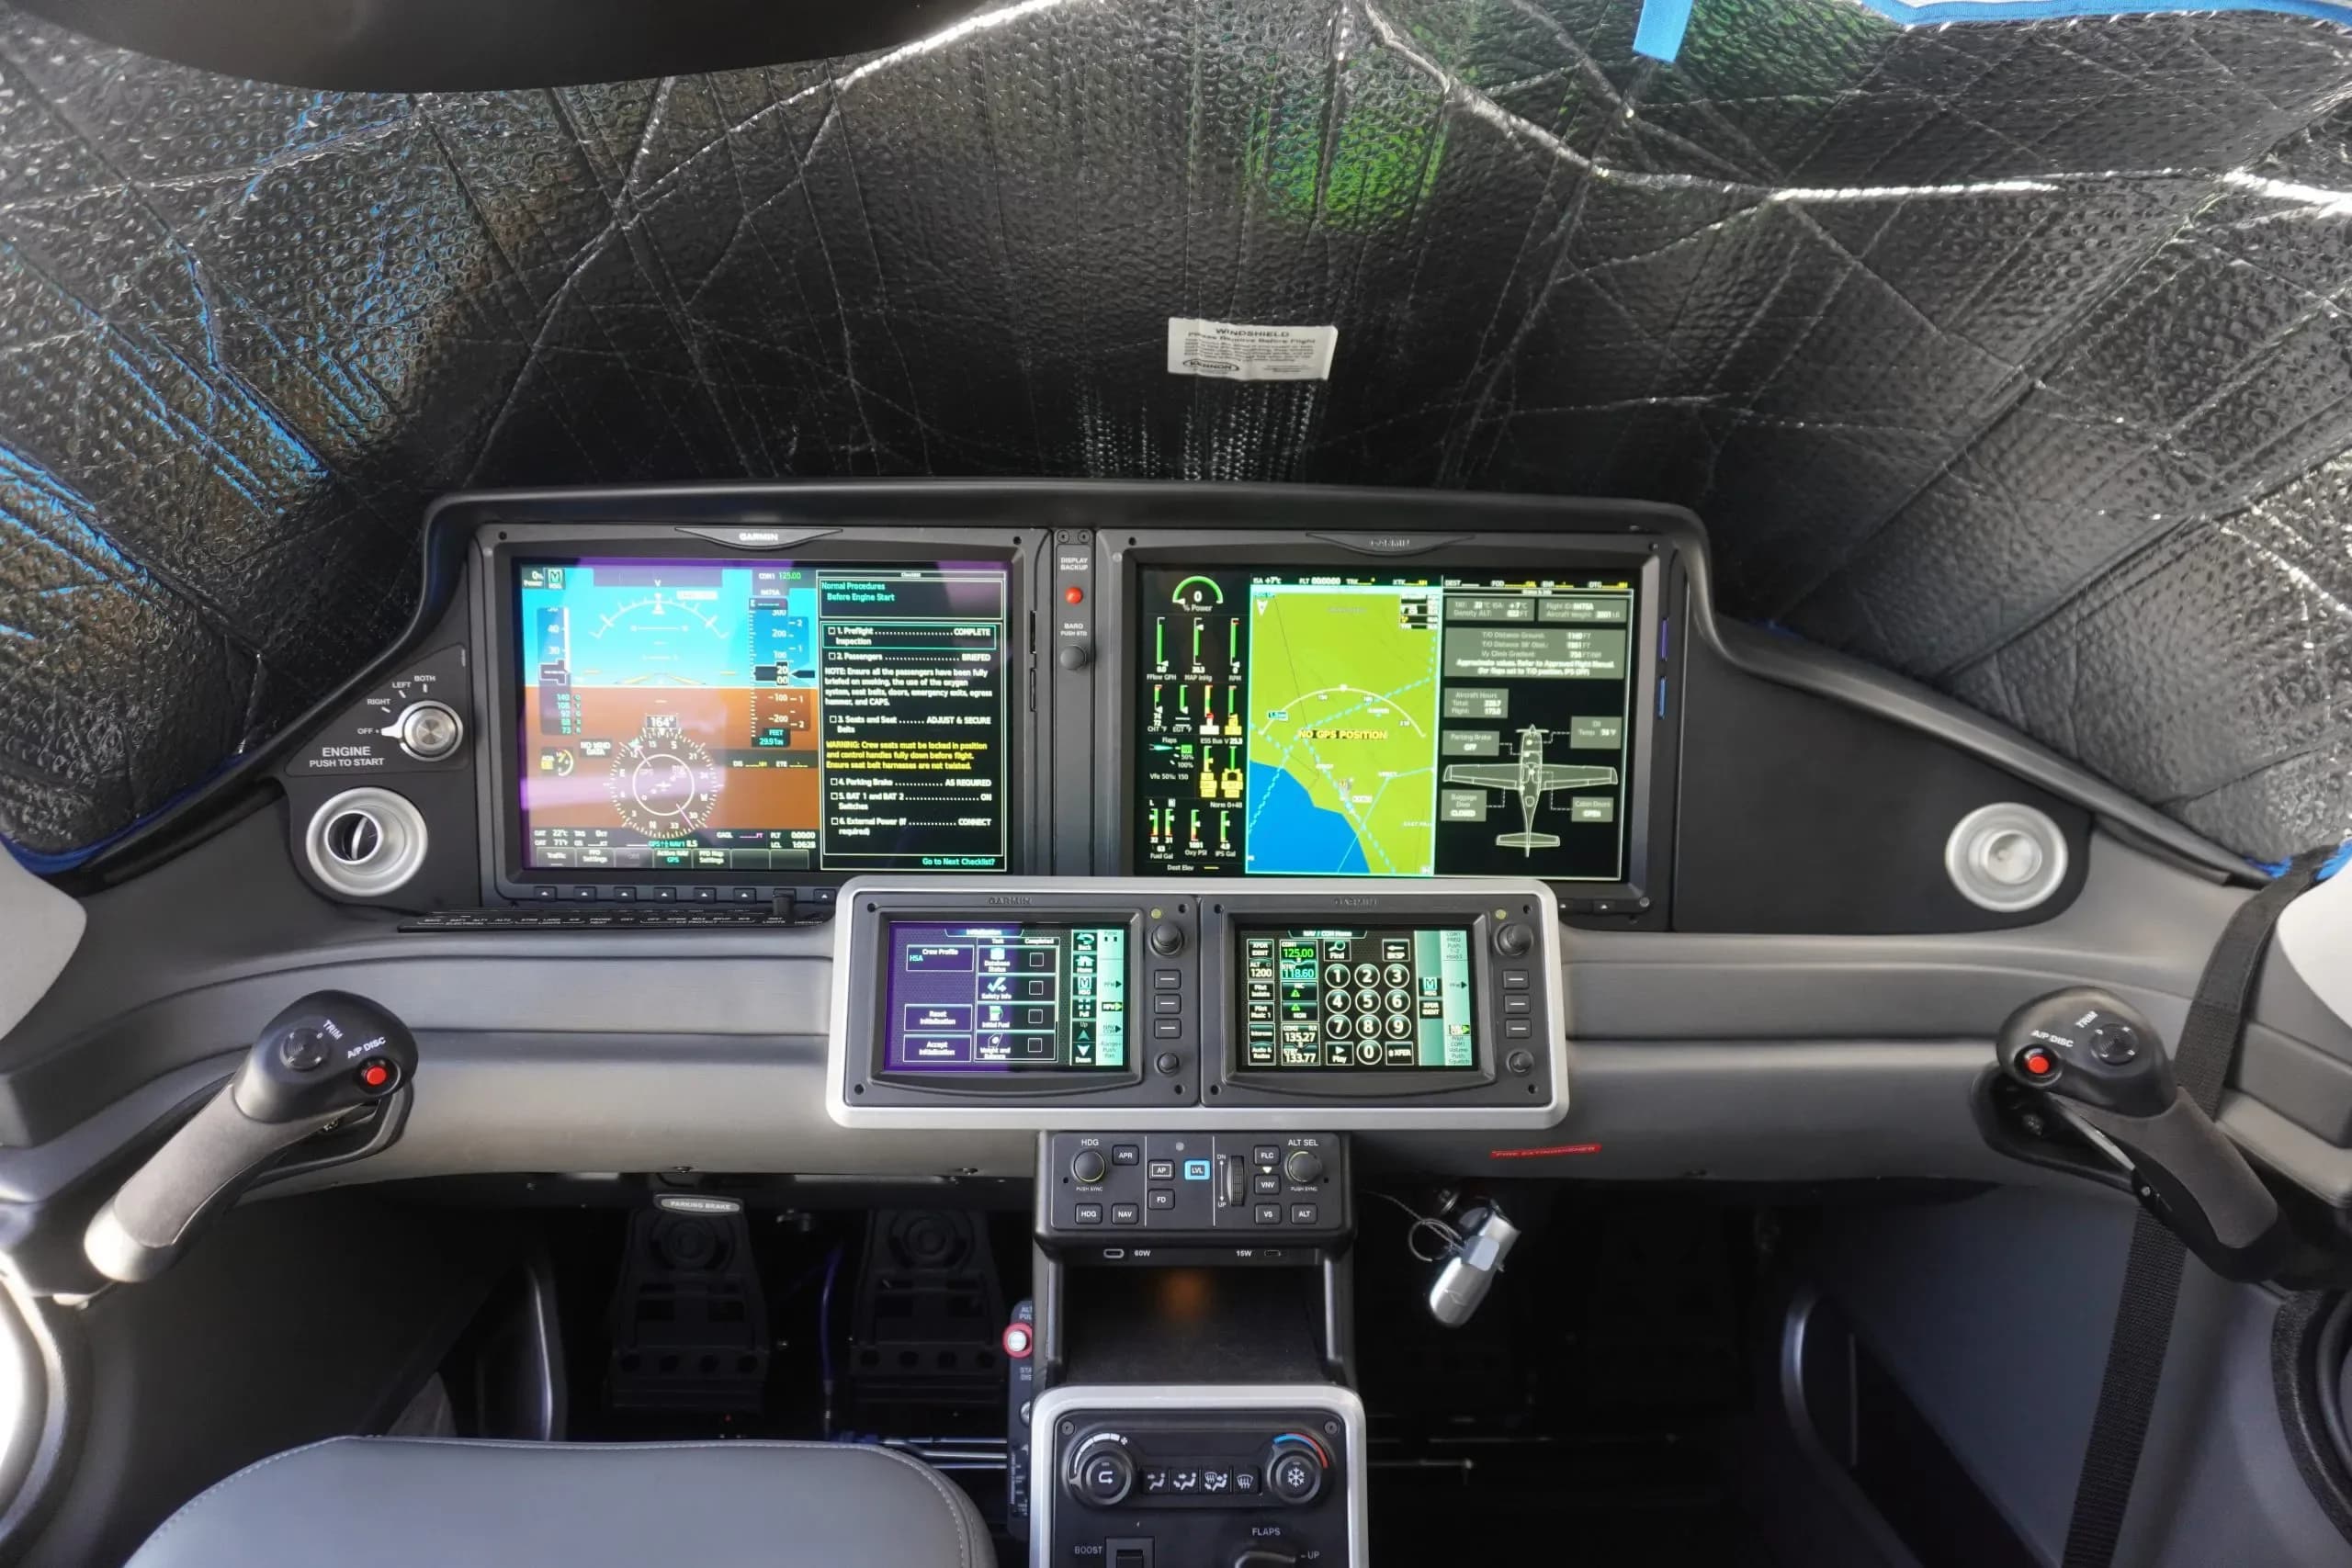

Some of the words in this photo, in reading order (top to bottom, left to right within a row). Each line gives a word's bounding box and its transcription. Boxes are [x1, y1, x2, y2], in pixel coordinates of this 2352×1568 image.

[1216, 329, 1290, 337] WINDSHIELD
[739, 533, 778, 541] GARMIN
[821, 582, 845, 591] Normal
[847, 582, 886, 591] Procedures
[852, 593, 876, 603] Engine
[876, 593, 895, 602] Start
[1193, 591, 1203, 603] 0
[843, 626, 874, 637] Preflight
[954, 627, 991, 637] COMPLETE
[835, 637, 872, 646] Inspection
[844, 652, 883, 661] Passengers
[961, 653, 991, 661] BRIEFED
[824, 667, 846, 675] NOTE:
[847, 667, 870, 675] Ensure
[895, 669, 934, 677] passengers
[972, 669, 989, 678] fully
[824, 677, 850, 685] briefed
[943, 680, 968, 688] oxygen
[845, 716, 865, 724] Seats
[866, 716, 880, 724] and
[880, 716, 897, 724] Seat
[926, 716, 956, 724] ADJUST
[964, 716, 991, 725] SECURE
[837, 725, 855, 733] Belts
[1298, 729, 1313, 739] NO
[1317, 730, 1337, 739] GPS
[1339, 730, 1387, 739] POSITION
[825, 740, 860, 749] WARNING:
[928, 741, 951, 750] locked
[960, 742, 988, 750] position
[322, 746, 371, 757] ENGINE
[894, 751, 910, 760] fully
[354, 758, 384, 766] START
[846, 778, 872, 787] Parking
[957, 818, 992, 826] CONNECT
[1283, 948, 1314, 958] 125.00
[1250, 968, 1272, 977] 1200
[1283, 968, 1314, 978] 118.60
[1334, 970, 1340, 983] 1
[1363, 970, 1372, 983] 2
[1392, 970, 1402, 983] 3
[1332, 995, 1342, 1008] 4
[1363, 995, 1373, 1008] 5
[1392, 995, 1402, 1008] 6
[2075, 1010, 2098, 1028] TRIM
[323, 1019, 345, 1041] TRIM
[1334, 1020, 1343, 1033] 7
[1363, 1020, 1374, 1033] 8
[1393, 1020, 1404, 1033] 9
[1284, 1032, 1316, 1042] 135.27
[2030, 1030, 2050, 1039] A/P
[2050, 1035, 2075, 1048] DISC
[347, 1046, 362, 1059] A/P
[363, 1036, 386, 1052] DISC
[1363, 1045, 1374, 1058] 0
[1285, 1053, 1316, 1063] 133.77
[1332, 1055, 1347, 1064] Play
[1080, 1210, 1096, 1218] HDG
[1118, 1210, 1132, 1218] NAV
[1251, 1528, 1281, 1536] FLAPS
[1075, 1546, 1102, 1554] BOOST
[1307, 1551, 1319, 1559] UP
